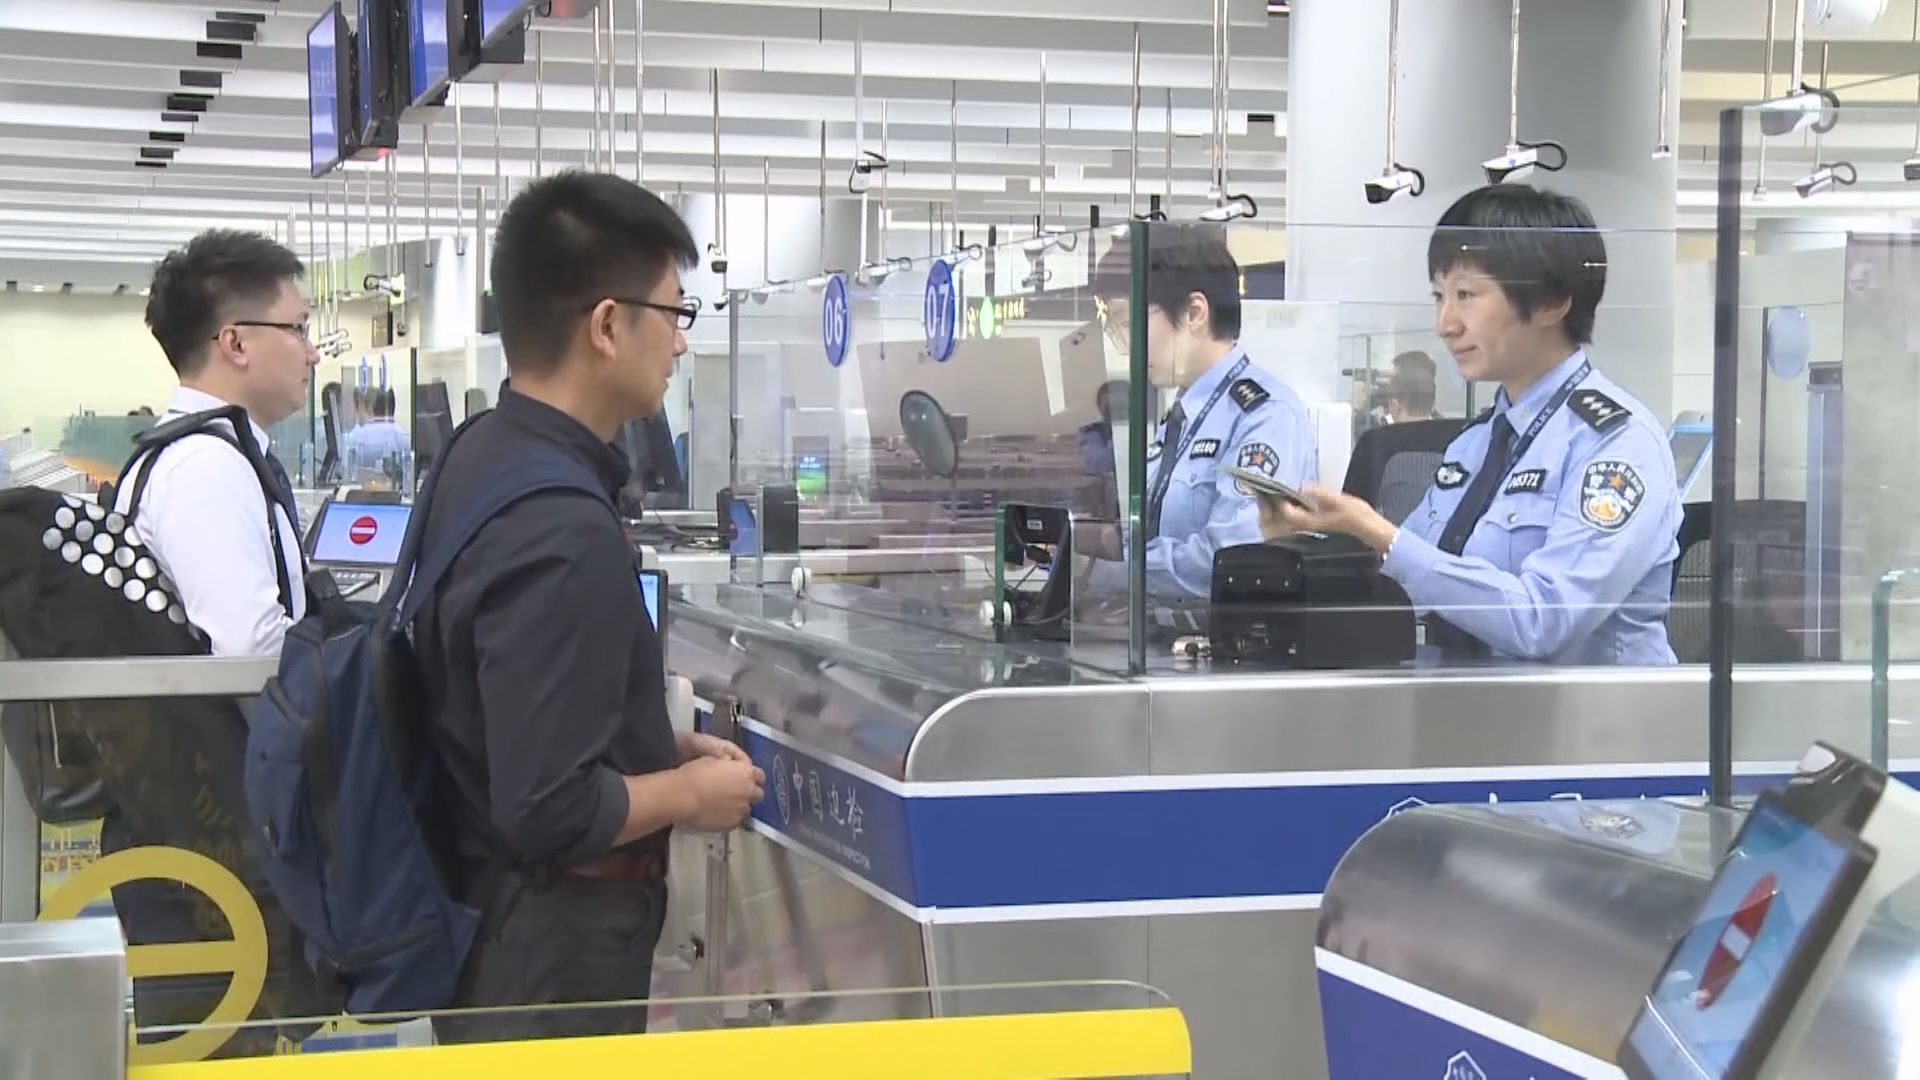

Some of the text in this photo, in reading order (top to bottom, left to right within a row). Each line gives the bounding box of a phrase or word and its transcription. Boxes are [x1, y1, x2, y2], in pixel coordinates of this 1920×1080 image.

[825, 296, 843, 346] 06
[926, 283, 950, 339] 07
[1527, 408, 1553, 437] POLICE
